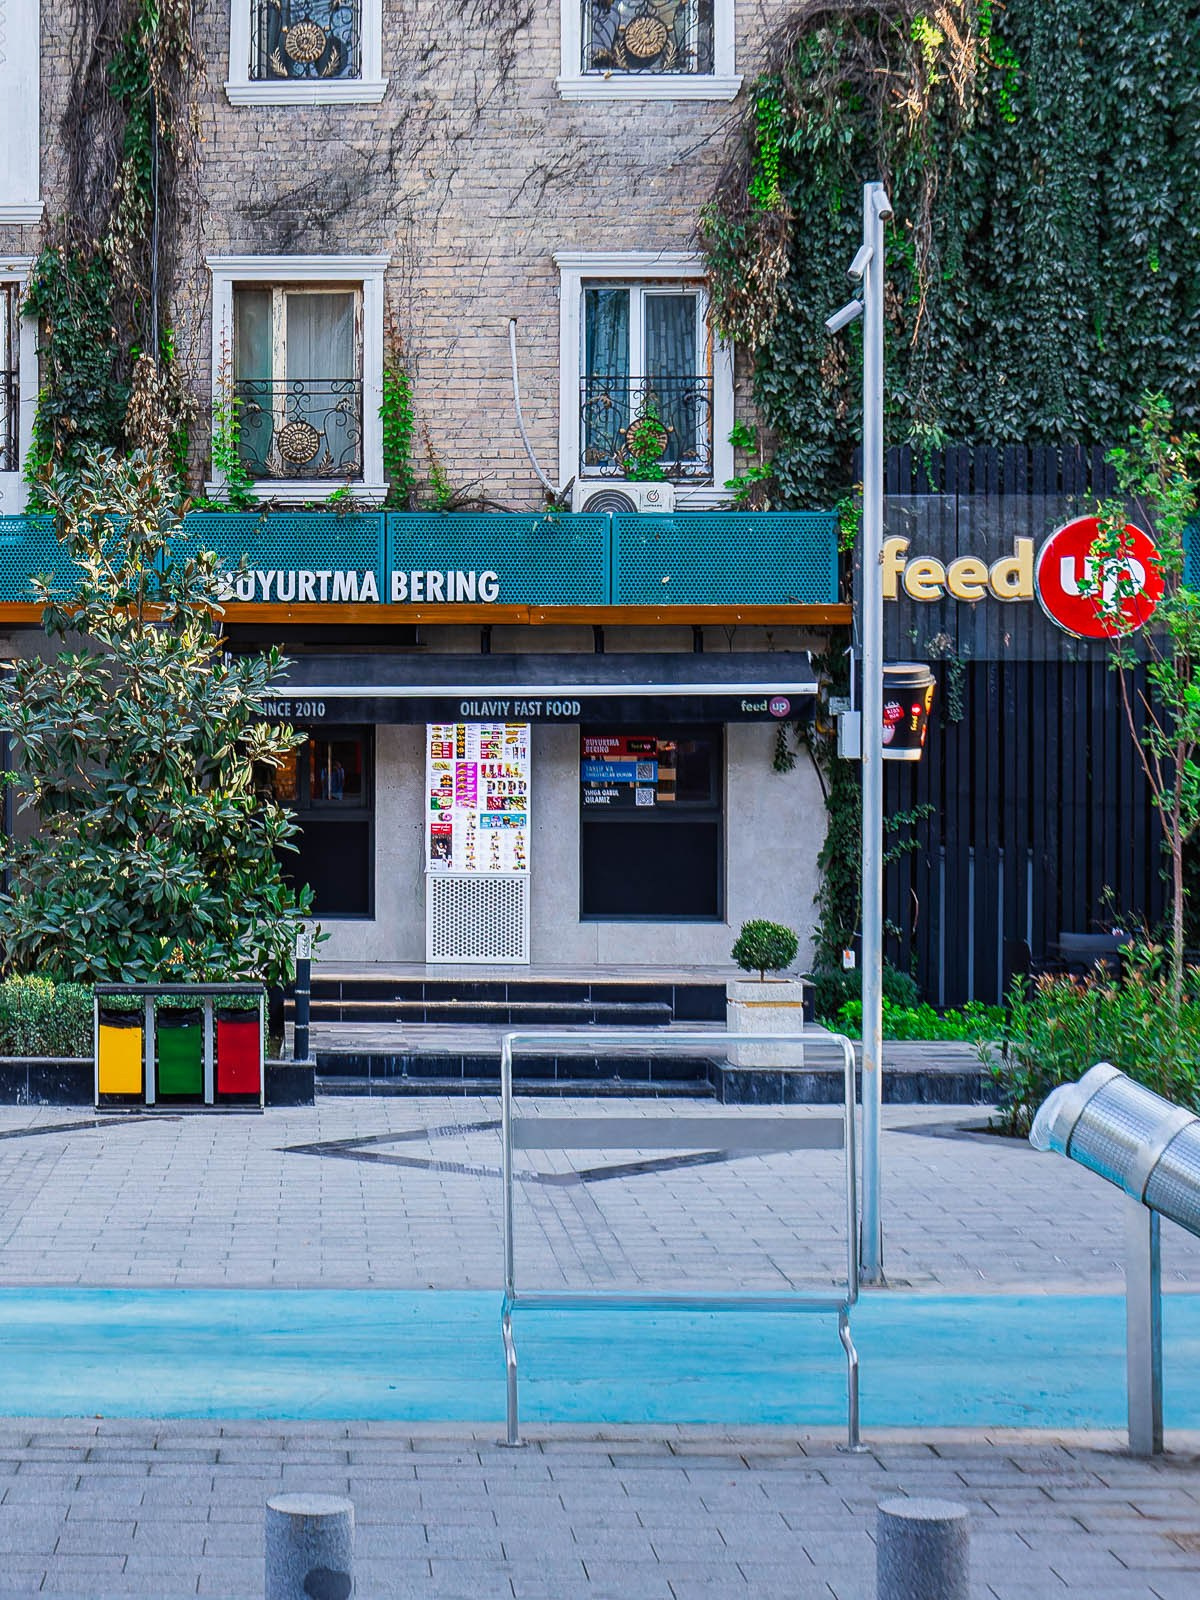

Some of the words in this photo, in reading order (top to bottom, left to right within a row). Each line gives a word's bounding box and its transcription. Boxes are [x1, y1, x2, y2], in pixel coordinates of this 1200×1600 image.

[882, 536, 1035, 600] feed
[1060, 555, 1146, 612] up
[391, 570, 500, 602] BERING
[295, 702, 326, 717] 2010
[460, 701, 510, 716] OILAVIY
[514, 701, 541, 716] FAST
[546, 701, 581, 716] FOOD
[741, 701, 768, 712] feed
[771, 702, 787, 713] up
